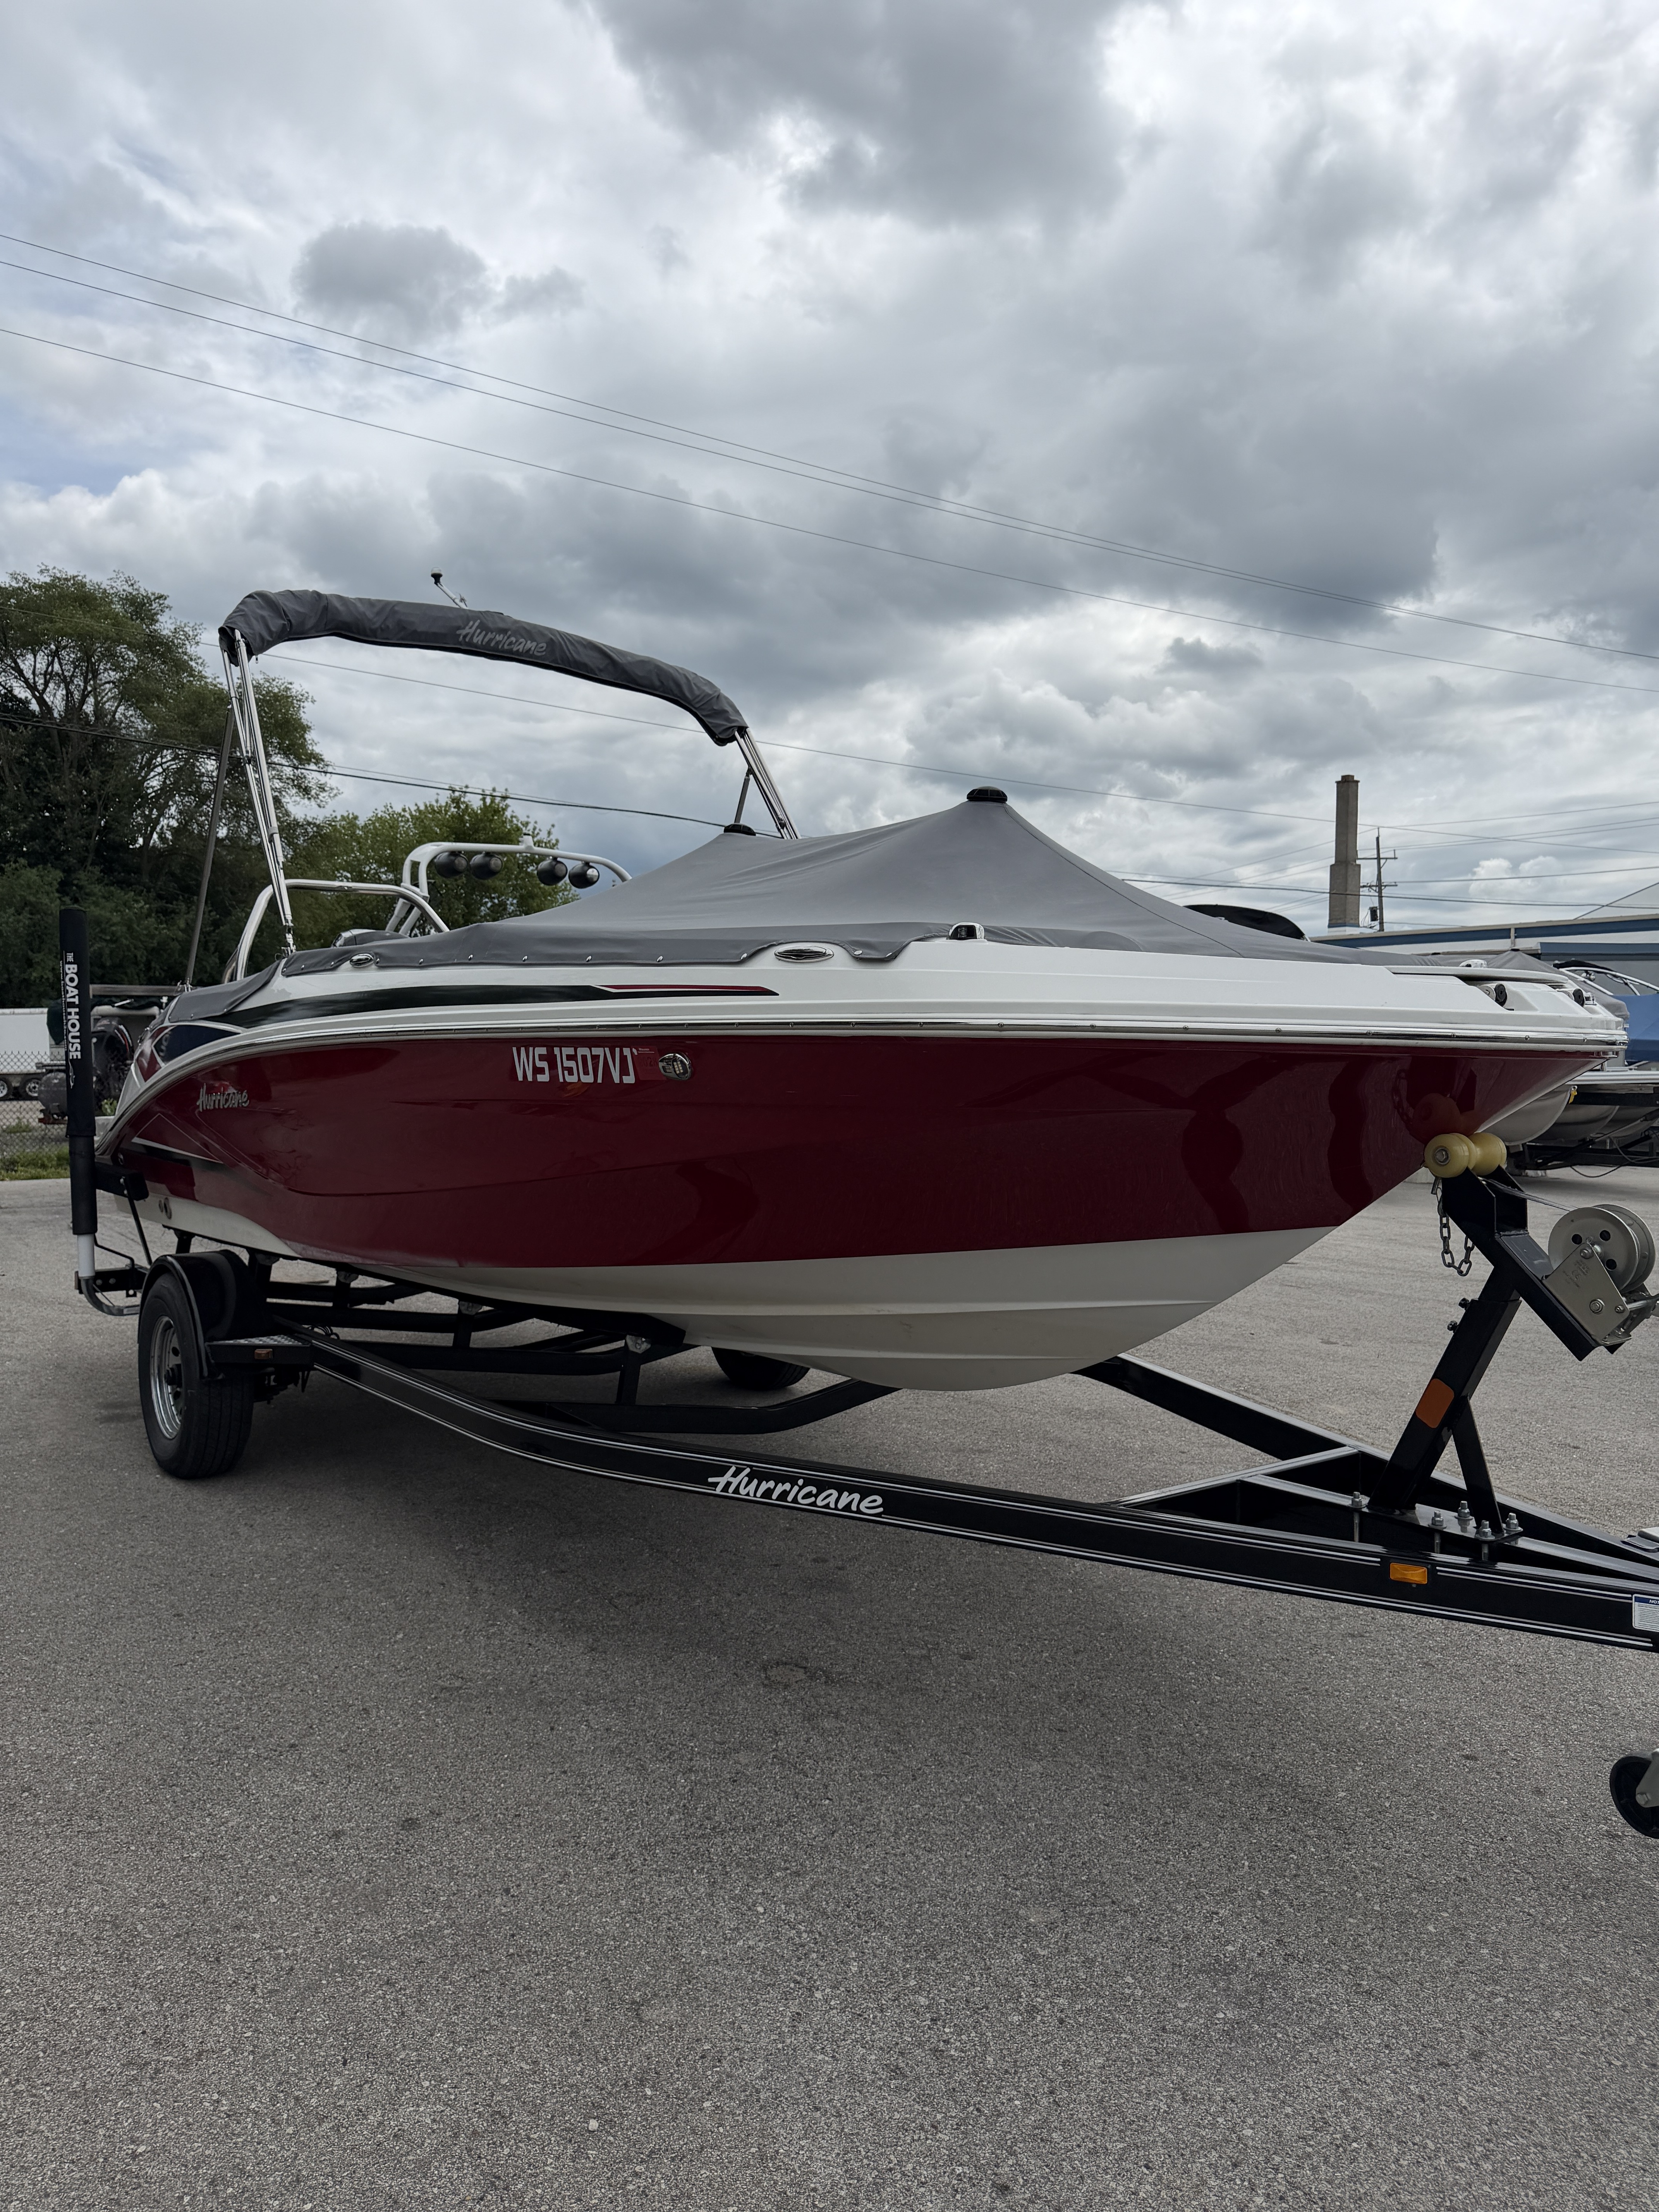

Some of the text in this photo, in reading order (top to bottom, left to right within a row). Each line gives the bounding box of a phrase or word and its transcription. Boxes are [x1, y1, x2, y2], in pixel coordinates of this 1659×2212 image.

[456, 620, 547, 656] Hurricane
[65, 964, 79, 1005] BOAT
[67, 1008, 81, 1059] HOUSE
[512, 1047, 635, 1084] WS 1507VJ
[196, 1083, 249, 1112] Hurricane
[708, 1465, 884, 1514] Hurricane
